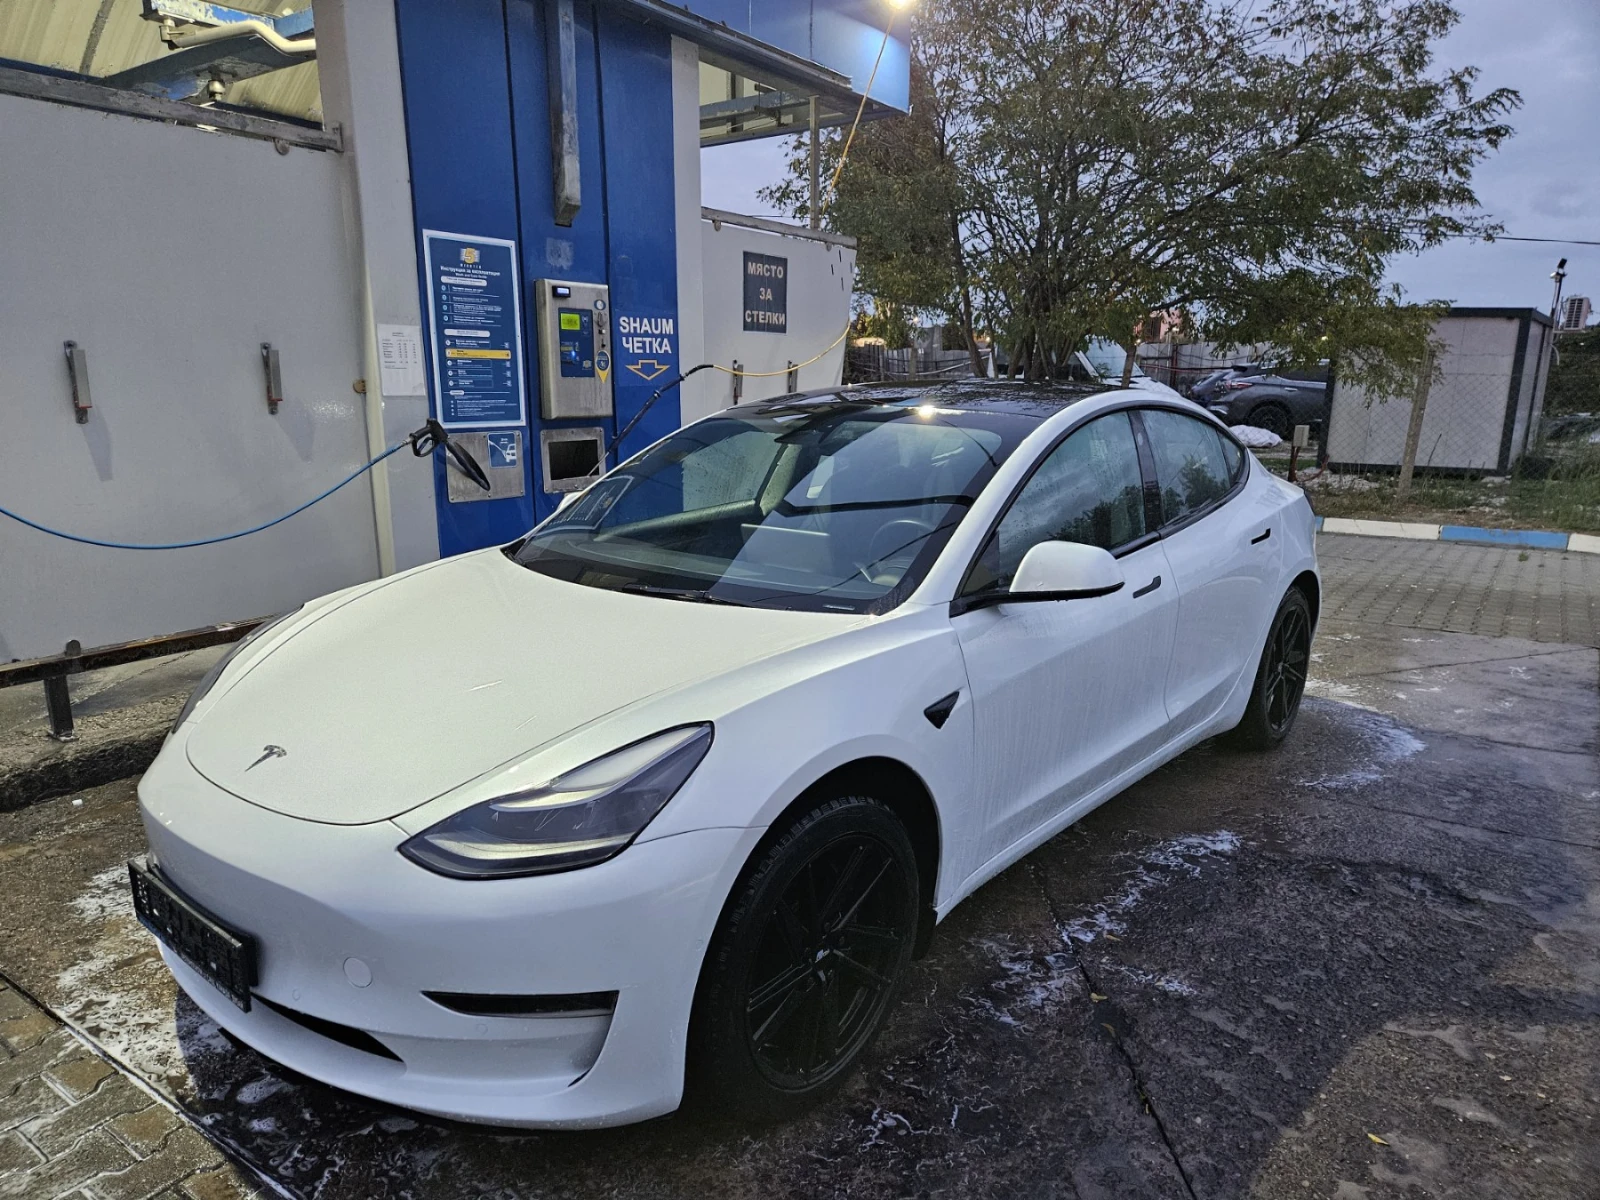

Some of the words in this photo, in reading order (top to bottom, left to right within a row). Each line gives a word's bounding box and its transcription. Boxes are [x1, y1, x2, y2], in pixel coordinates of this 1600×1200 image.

[464, 247, 476, 264] 5
[747, 261, 784, 279] МЯСТО
[759, 287, 773, 301] ЗА
[619, 316, 674, 335] SHAUM
[744, 309, 786, 325] СТЕЛКИ
[621, 336, 672, 354] ЧЕТКА
